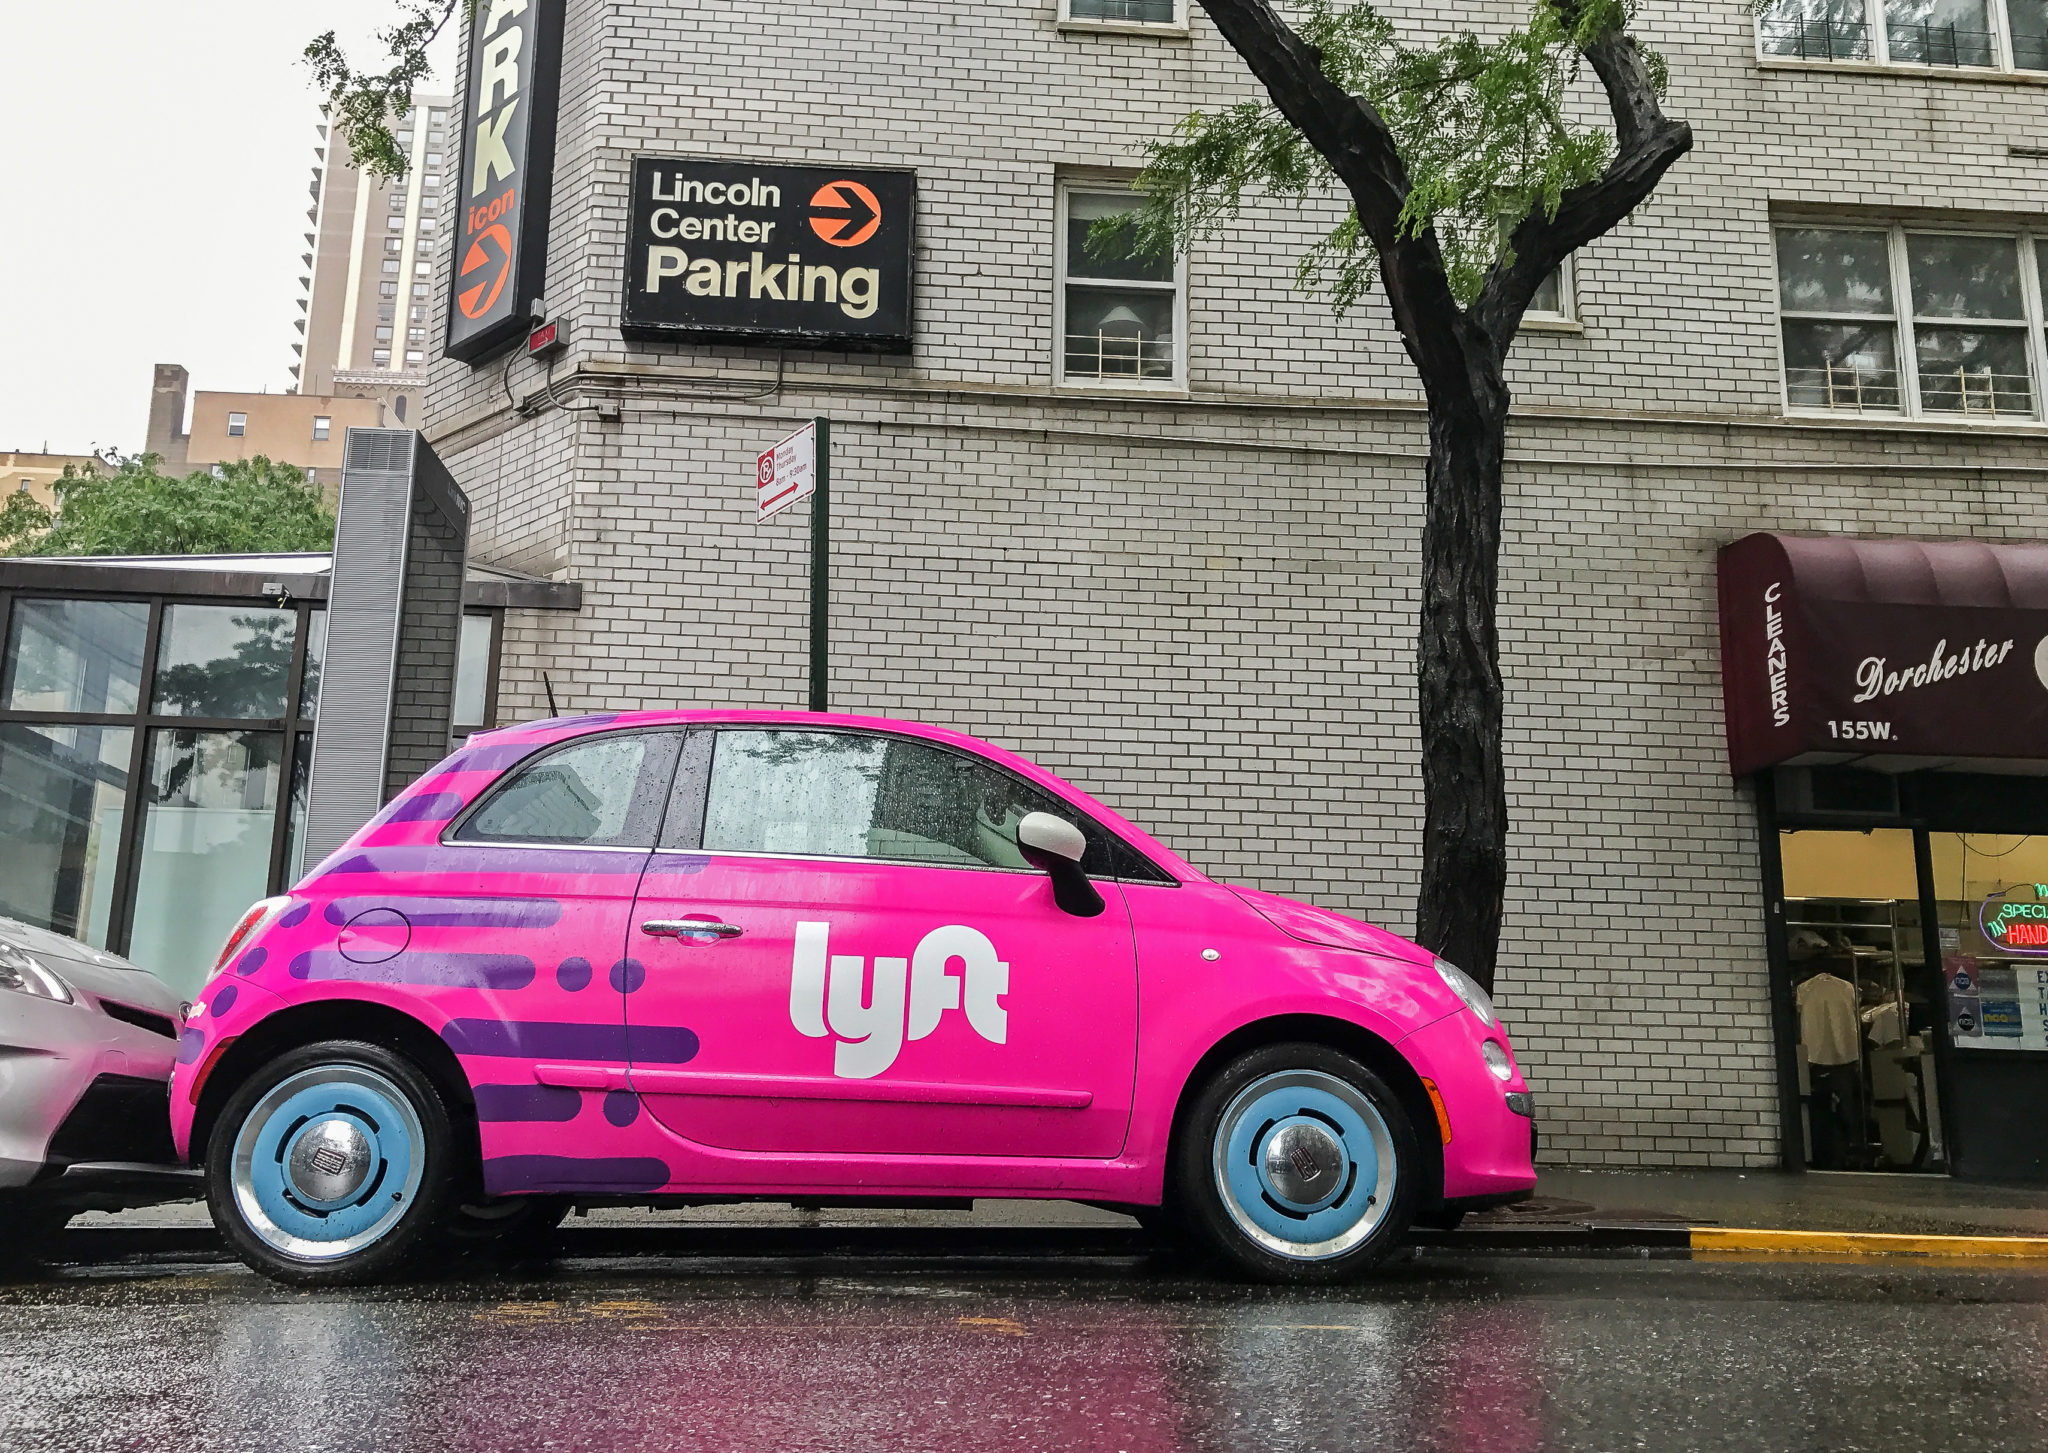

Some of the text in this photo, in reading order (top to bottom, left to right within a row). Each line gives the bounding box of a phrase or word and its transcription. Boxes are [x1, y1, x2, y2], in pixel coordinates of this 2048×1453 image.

[467, 188, 515, 235] icon
[652, 171, 781, 208] Lincoln
[650, 207, 776, 244] Center
[646, 245, 880, 319] Parking
[1764, 582, 1790, 727] CLEANERS
[1853, 638, 2014, 703] Dorchester
[2002, 903, 2048, 919] SPECI
[2007, 924, 2048, 945] HAND
[789, 921, 1009, 1079] lyft
